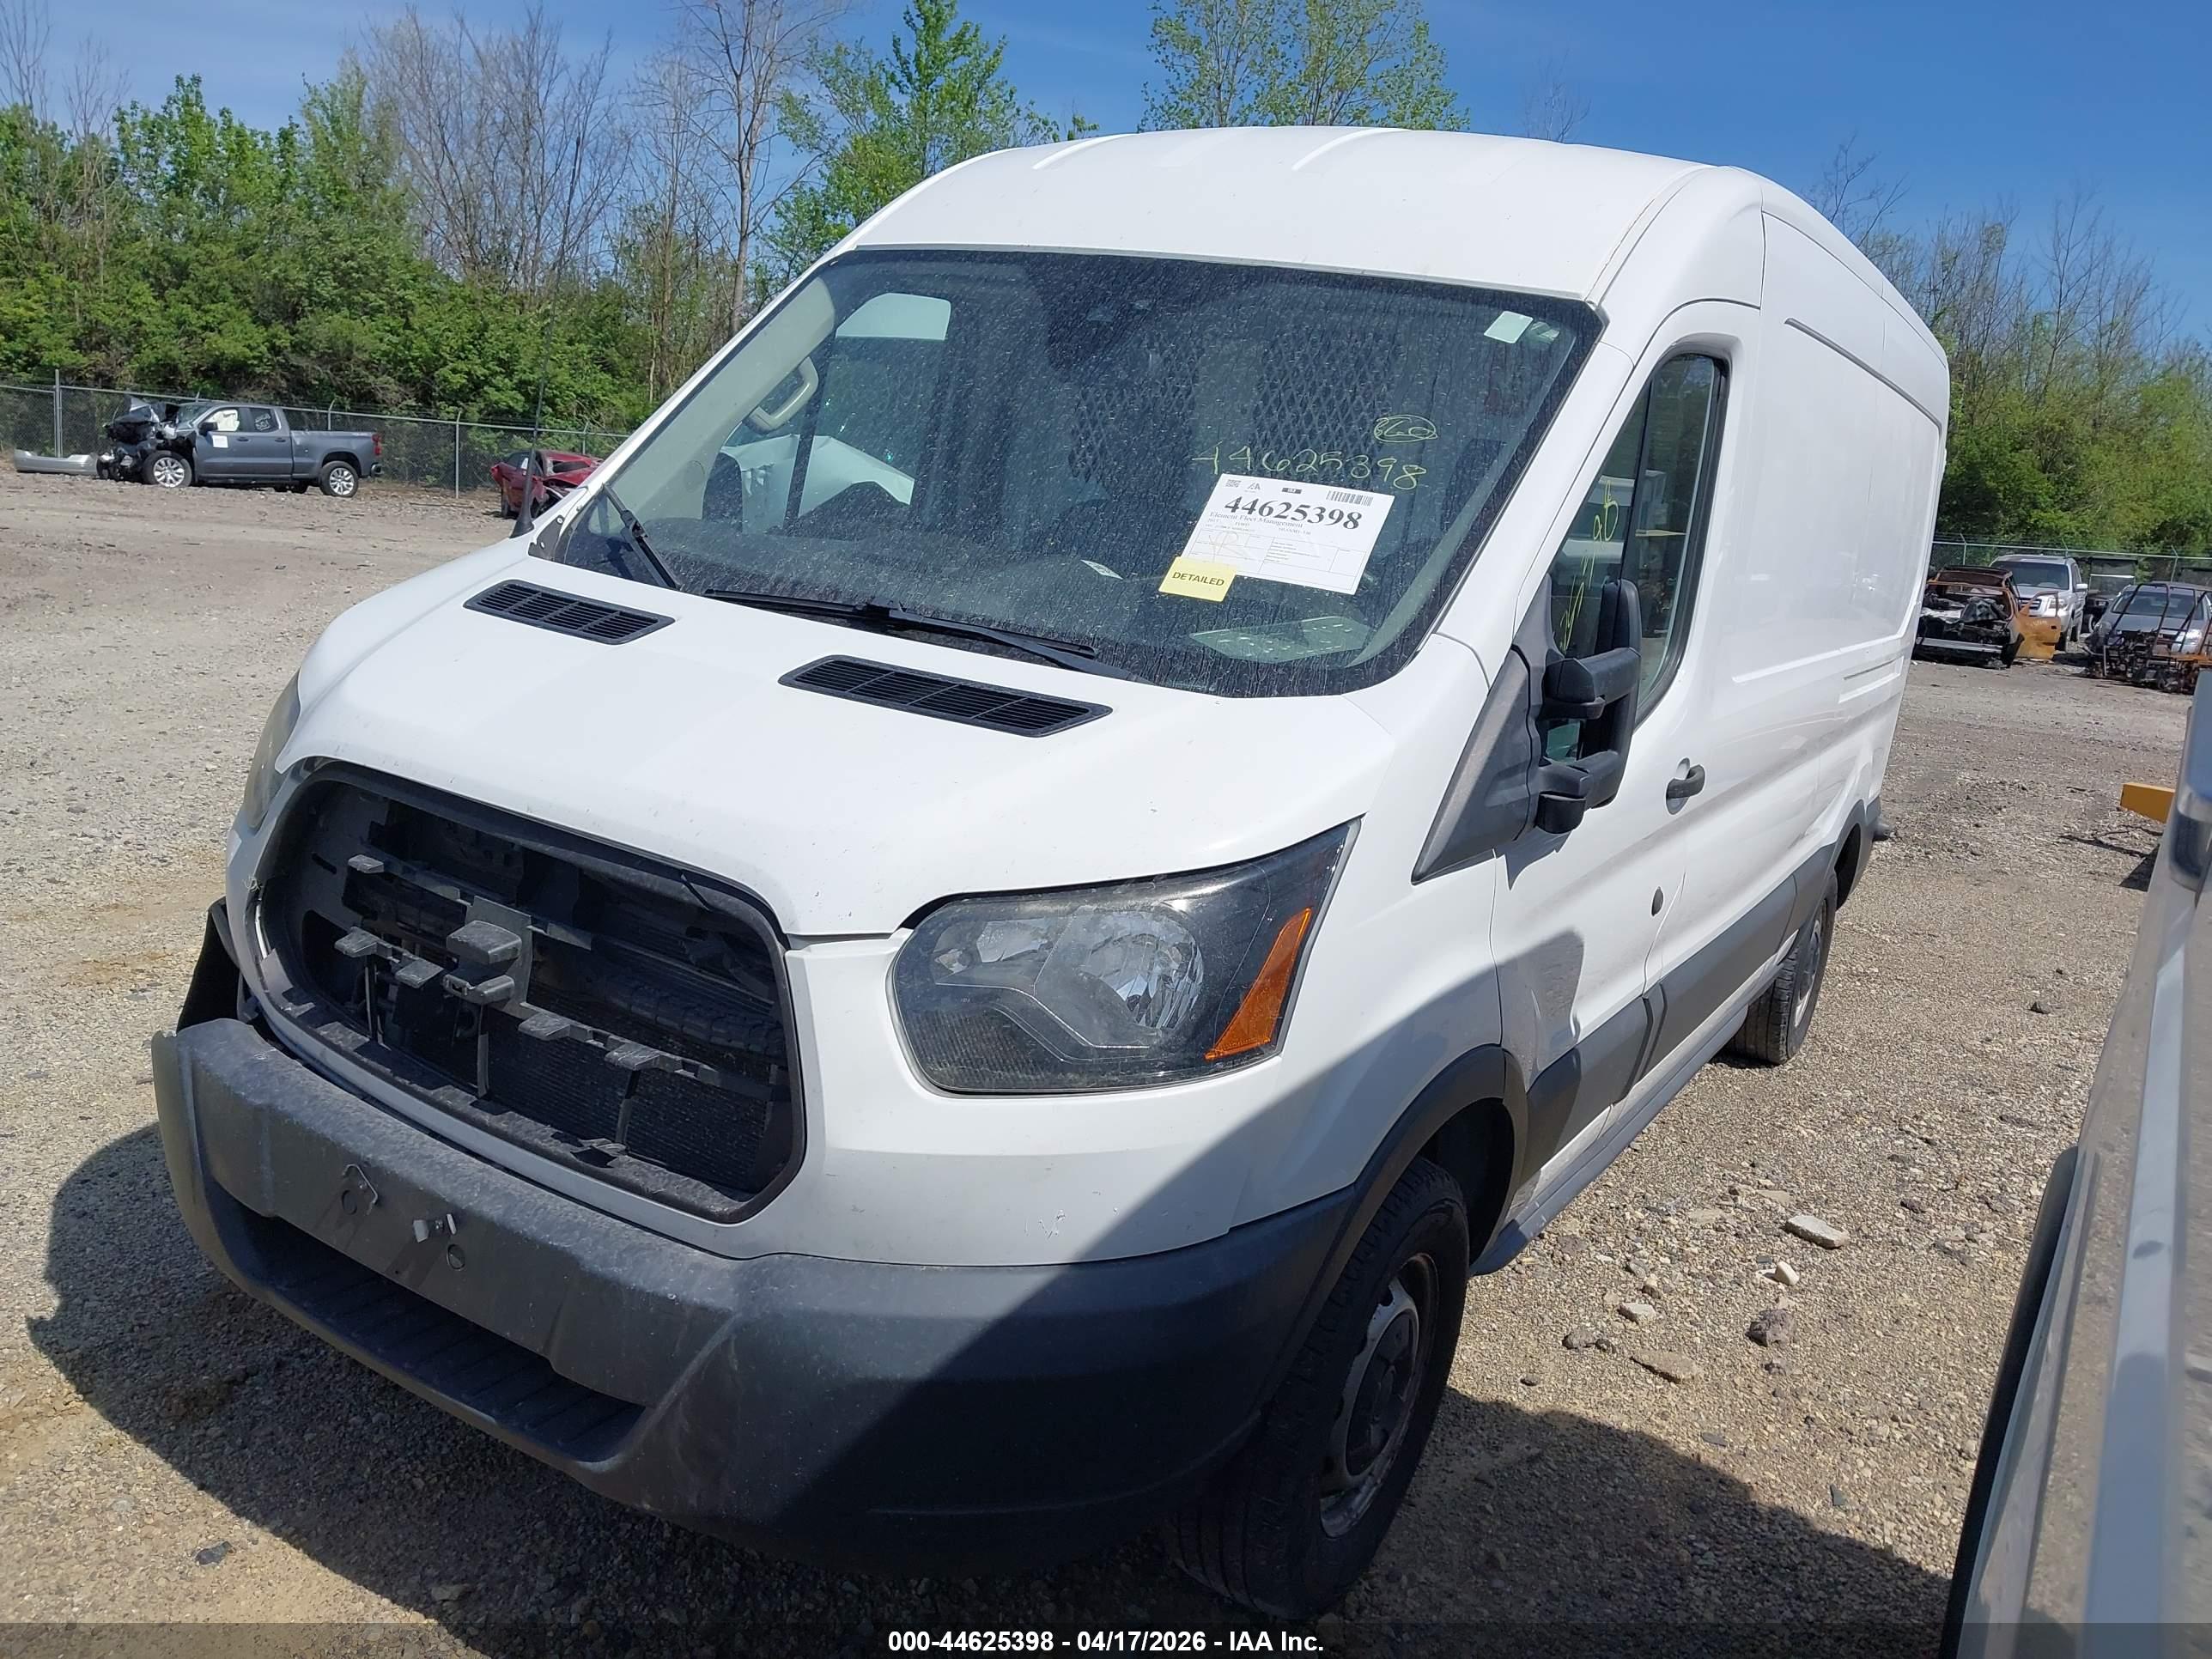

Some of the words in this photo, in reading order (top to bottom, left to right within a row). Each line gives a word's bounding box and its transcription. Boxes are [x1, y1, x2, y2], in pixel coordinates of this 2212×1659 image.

[1224, 495, 1363, 530] 44625398
[1258, 517, 1304, 528] Management
[1172, 572, 1224, 586] DETAILED
